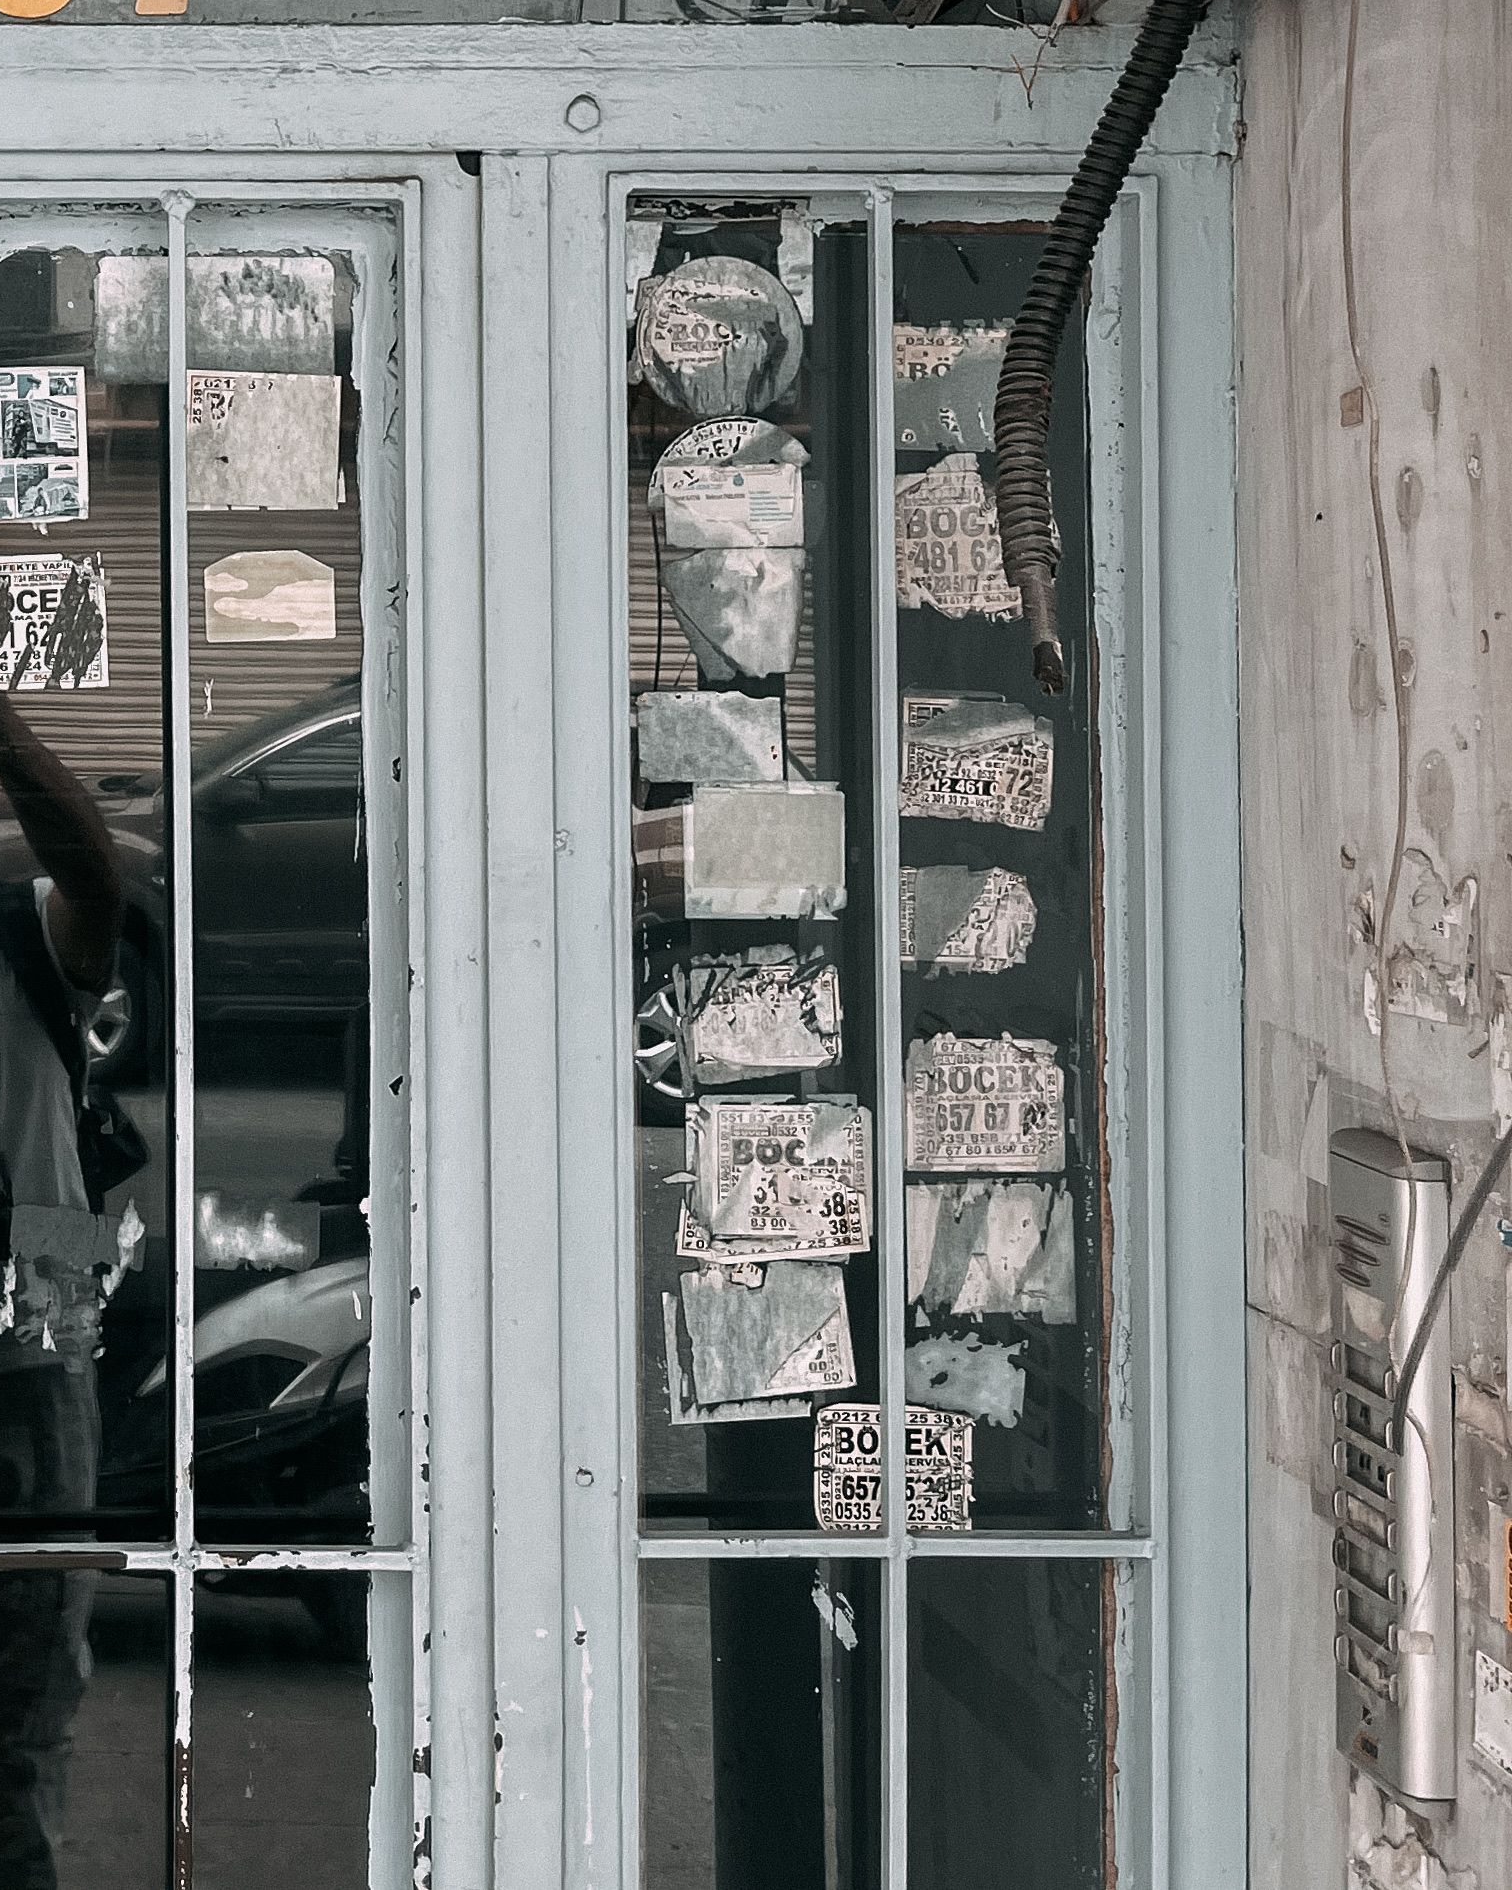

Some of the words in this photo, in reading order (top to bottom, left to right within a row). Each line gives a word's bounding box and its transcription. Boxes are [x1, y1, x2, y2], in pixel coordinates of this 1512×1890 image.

[955, 779, 984, 795] 461
[1005, 766, 1034, 797] 72
[926, 1065, 1044, 1096] BÖCEK
[936, 1103, 976, 1133] 657
[984, 1102, 1010, 1132] 67
[828, 1219, 849, 1236] 38
[807, 1238, 827, 1249] 25
[832, 1411, 871, 1423] 0212
[909, 1413, 928, 1424] 25
[835, 1425, 948, 1456] BÖEK
[841, 1475, 881, 1501] 657
[821, 1492, 831, 1523] 0535
[834, 1501, 871, 1521] 0535
